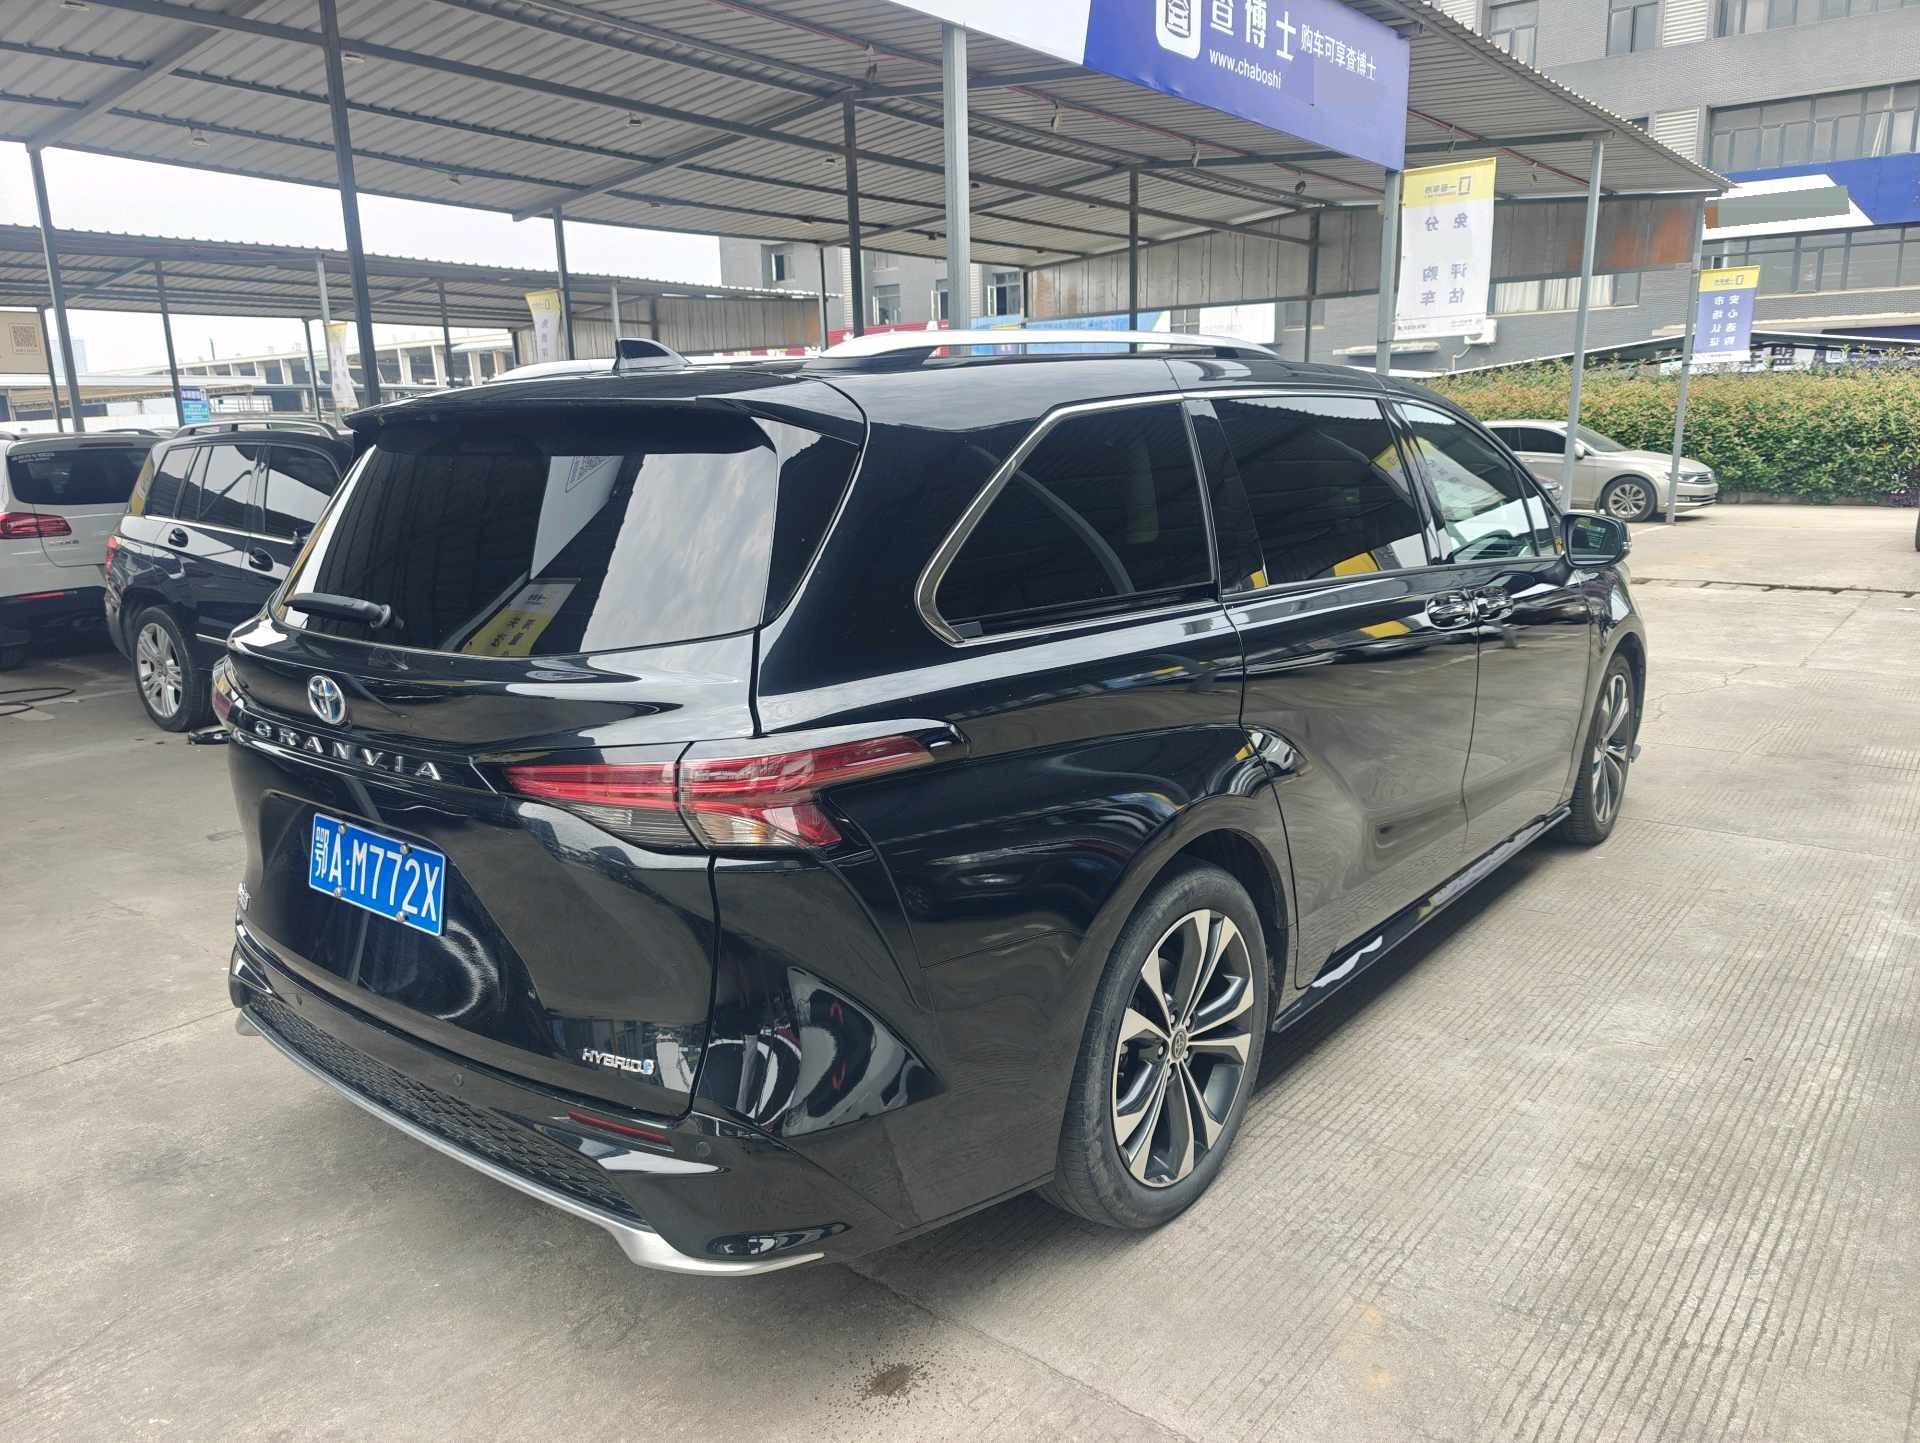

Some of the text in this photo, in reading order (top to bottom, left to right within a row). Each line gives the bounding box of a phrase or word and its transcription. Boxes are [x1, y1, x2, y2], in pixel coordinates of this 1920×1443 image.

[1209, 48, 1282, 90] www.chaboshi
[1300, 23, 1377, 82] 购车可享查博士
[254, 719, 442, 781] GRANVIA
[582, 1047, 643, 1073] HYBRID
